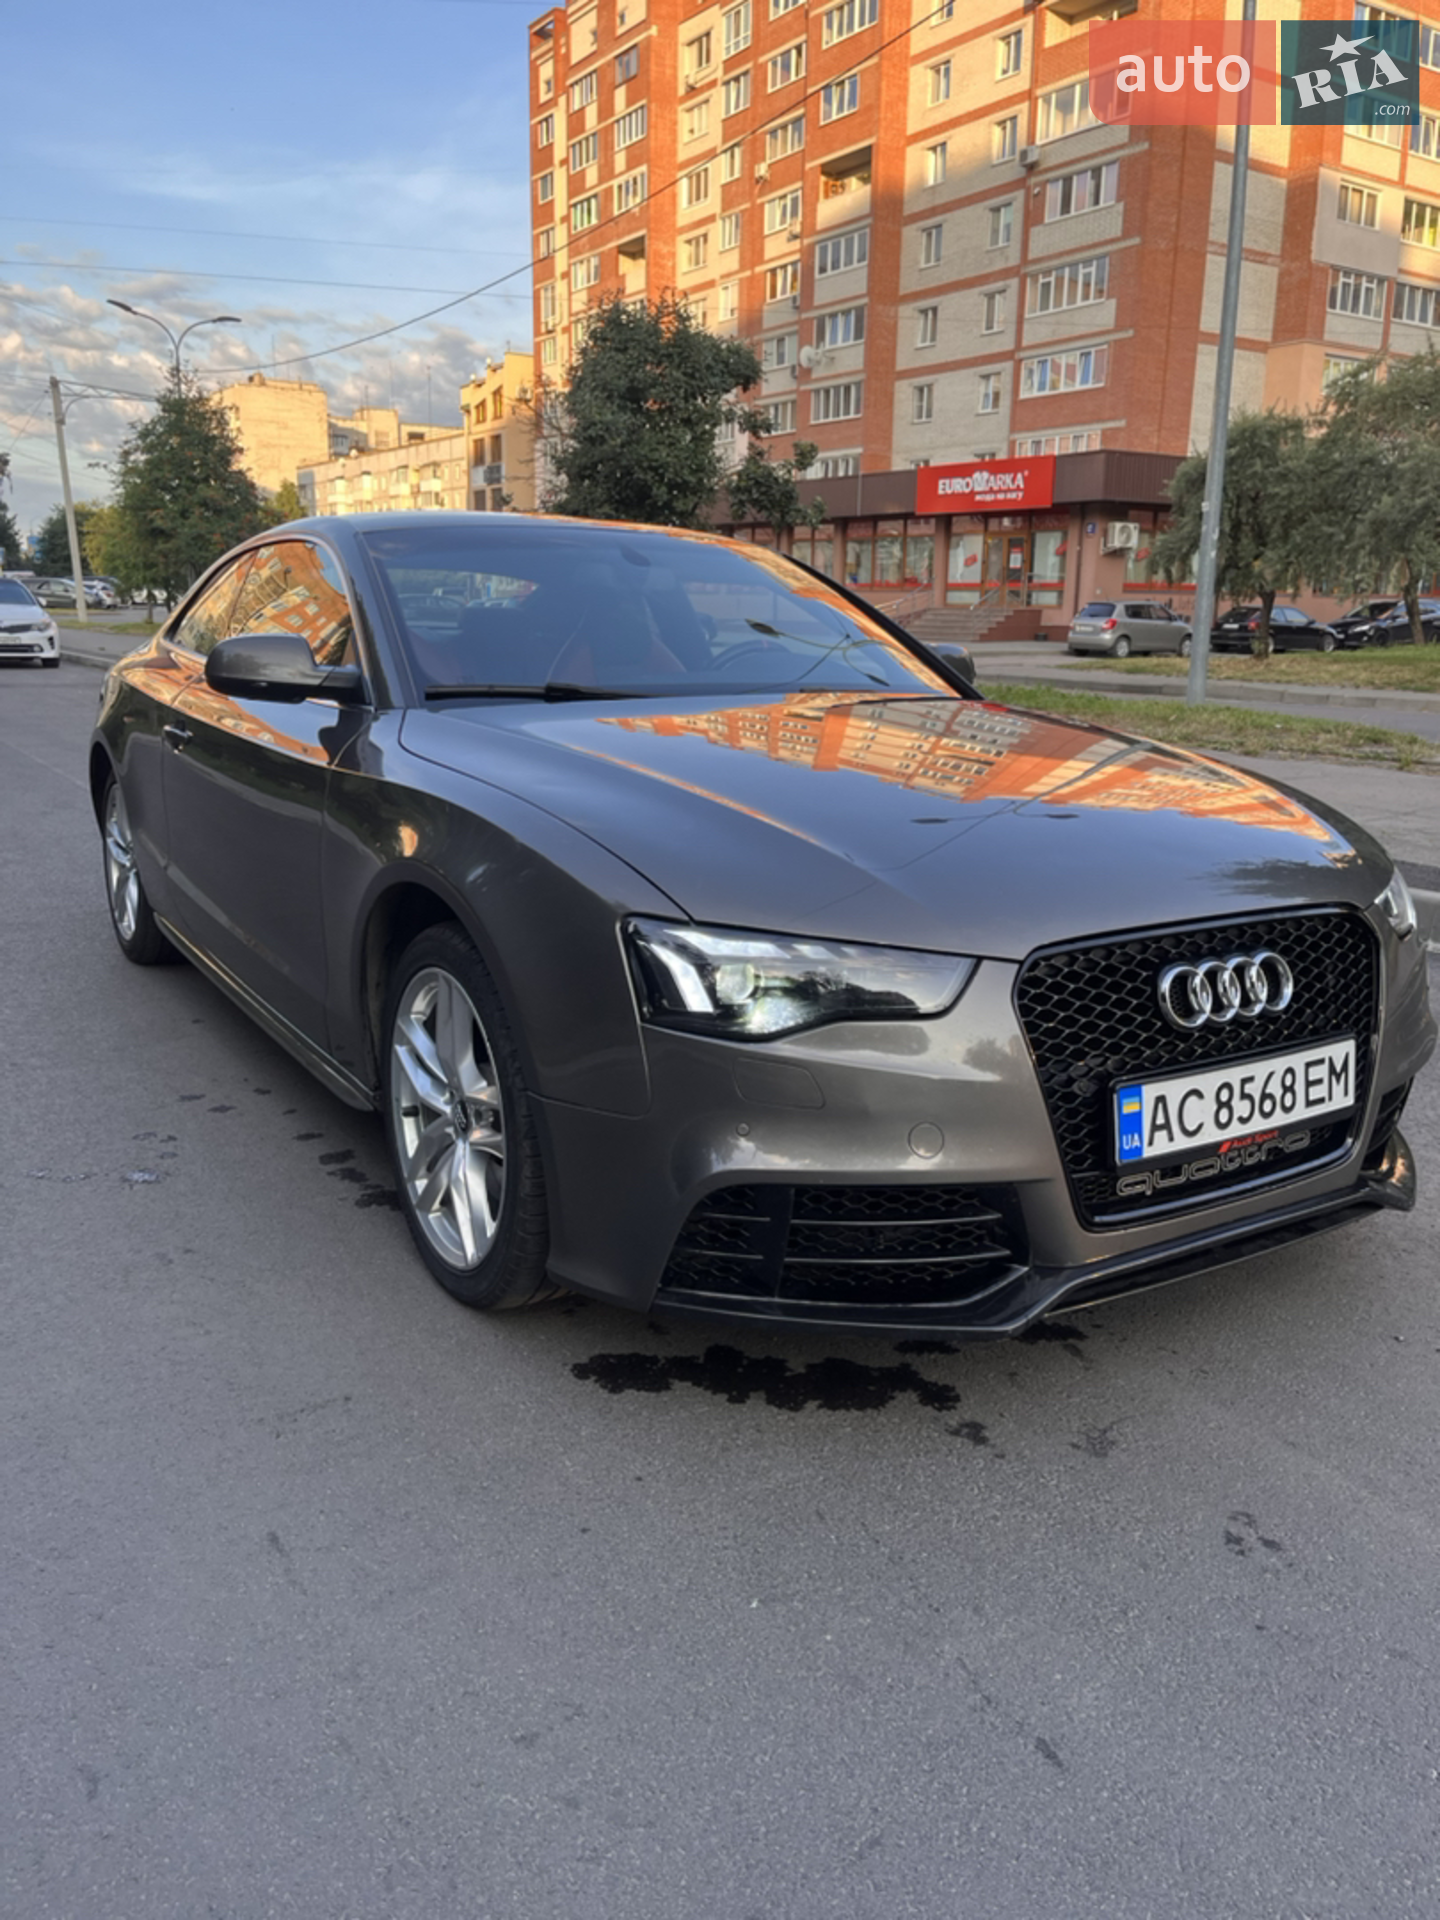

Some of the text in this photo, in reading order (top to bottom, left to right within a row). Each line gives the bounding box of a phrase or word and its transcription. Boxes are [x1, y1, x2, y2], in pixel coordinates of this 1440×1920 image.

[1147, 1052, 1350, 1147] AC 8568 EM
[1122, 1132, 1141, 1150] UA
[1230, 1129, 1279, 1149] Audi Sport
[1117, 1129, 1311, 1196] quattro
